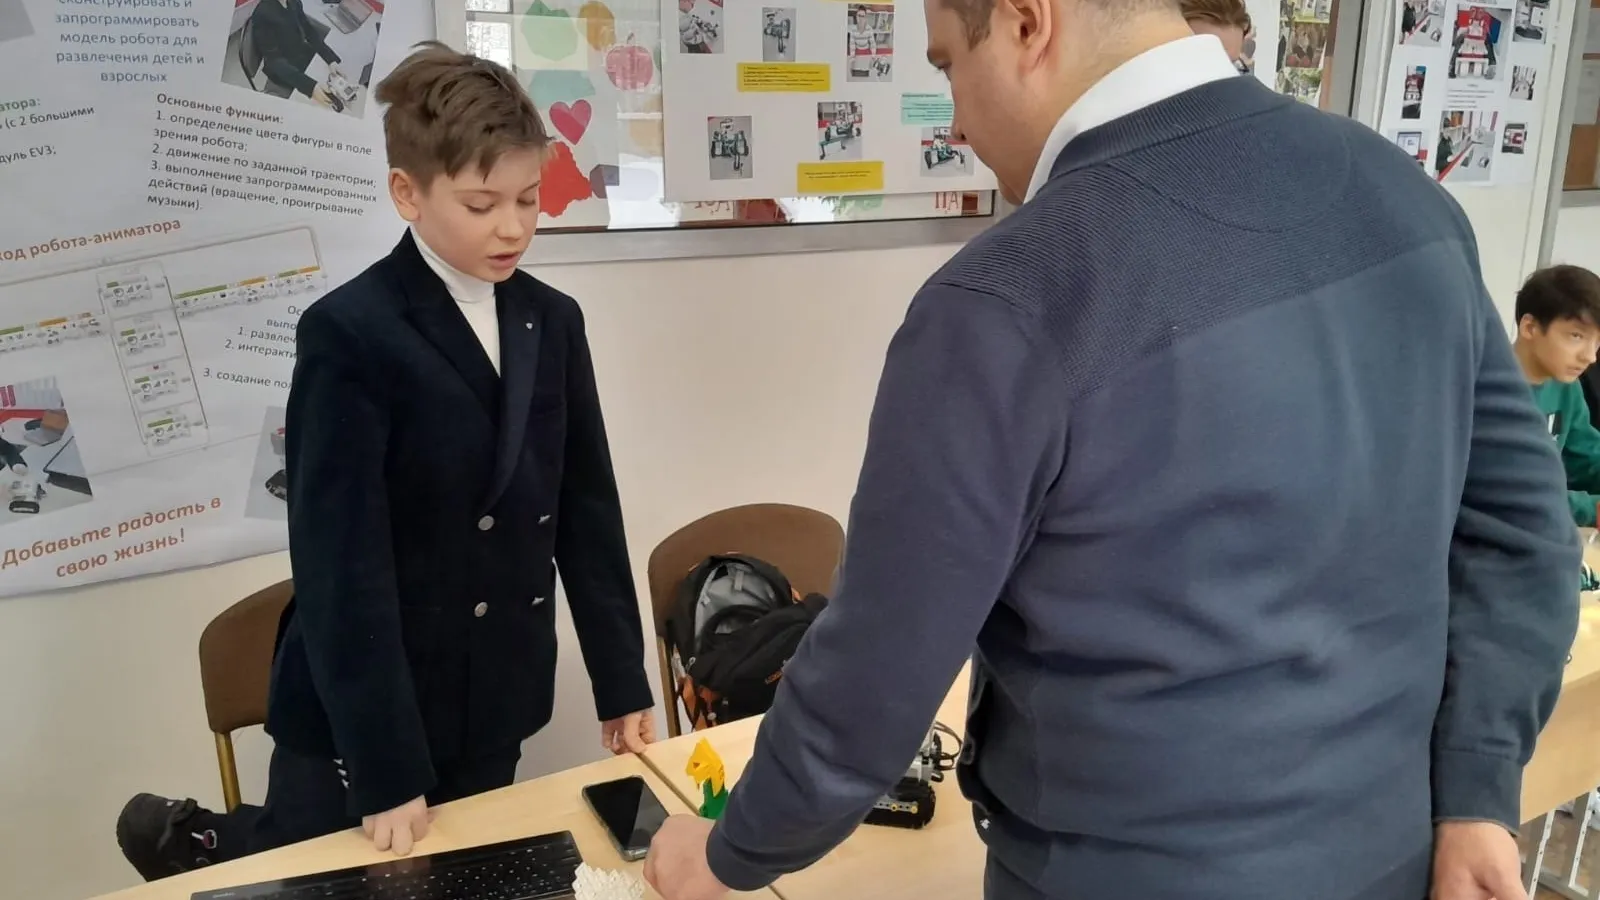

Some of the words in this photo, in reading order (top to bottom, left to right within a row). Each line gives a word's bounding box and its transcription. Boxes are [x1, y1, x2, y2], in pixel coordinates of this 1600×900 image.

[55, 13, 200, 28] запрограммировать
[60, 33, 116, 44] модель
[120, 33, 169, 45] робота
[173, 38, 198, 47] для
[56, 52, 148, 64] развлечения
[152, 52, 193, 65] детей
[196, 57, 205, 65] и
[100, 72, 168, 83] взрослых
[5, 117, 17, 130] (с
[19, 115, 27, 126] 2
[29, 106, 95, 124] большими
[156, 93, 222, 113] Основные
[225, 106, 284, 123] функции:
[153, 128, 199, 143] зрения
[201, 136, 248, 153] робота;
[156, 110, 166, 121] 1.
[170, 114, 253, 135] определение
[255, 129, 289, 141] цвета
[291, 133, 334, 149] фигуры
[336, 142, 343, 151] в
[346, 144, 372, 156] поле
[152, 142, 163, 155] 2.
[165, 147, 231, 164] движение
[233, 158, 249, 168] по
[251, 160, 307, 177] заданной
[310, 168, 377, 189] траектории;
[151, 159, 161, 171] 3.
[165, 163, 243, 183] выполнение
[245, 175, 377, 203] запрограммированных
[147, 195, 203, 212] музыки).
[148, 178, 208, 195] действий
[210, 185, 279, 205] (вращение,
[281, 197, 365, 216] проигрывание
[29, 218, 182, 258] робота-аниматора
[250, 330, 298, 344] развлеч
[266, 319, 298, 331] выпо
[224, 339, 235, 351] 2.
[202, 367, 213, 378] 3.
[216, 371, 271, 387] создание
[1, 526, 112, 569] Добавьте
[117, 502, 206, 538] радость
[210, 497, 222, 509] в
[55, 553, 109, 578] свою
[113, 527, 186, 562] жизнь!
